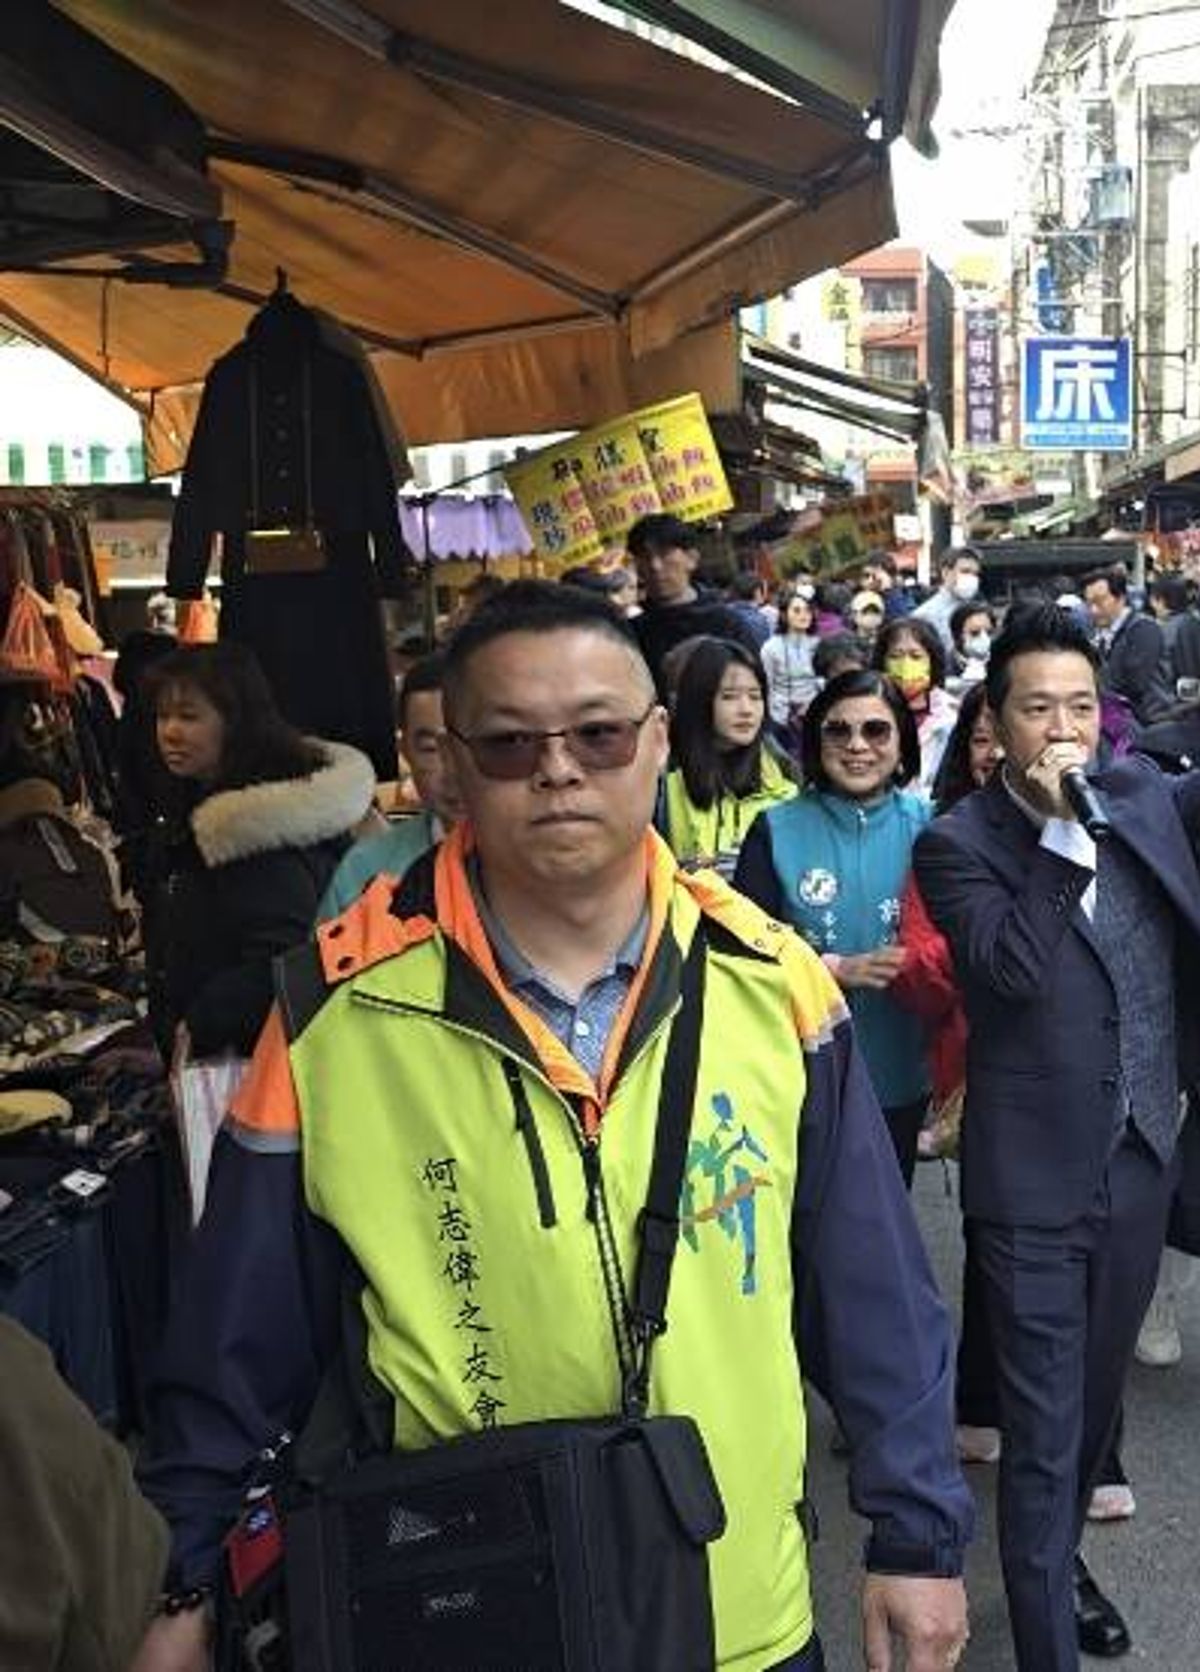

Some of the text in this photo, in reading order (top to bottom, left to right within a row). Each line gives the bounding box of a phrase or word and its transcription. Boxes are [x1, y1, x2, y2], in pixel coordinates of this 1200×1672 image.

[1036, 346, 1119, 421] 床
[422, 1157, 507, 1430] 何志偉之友會
